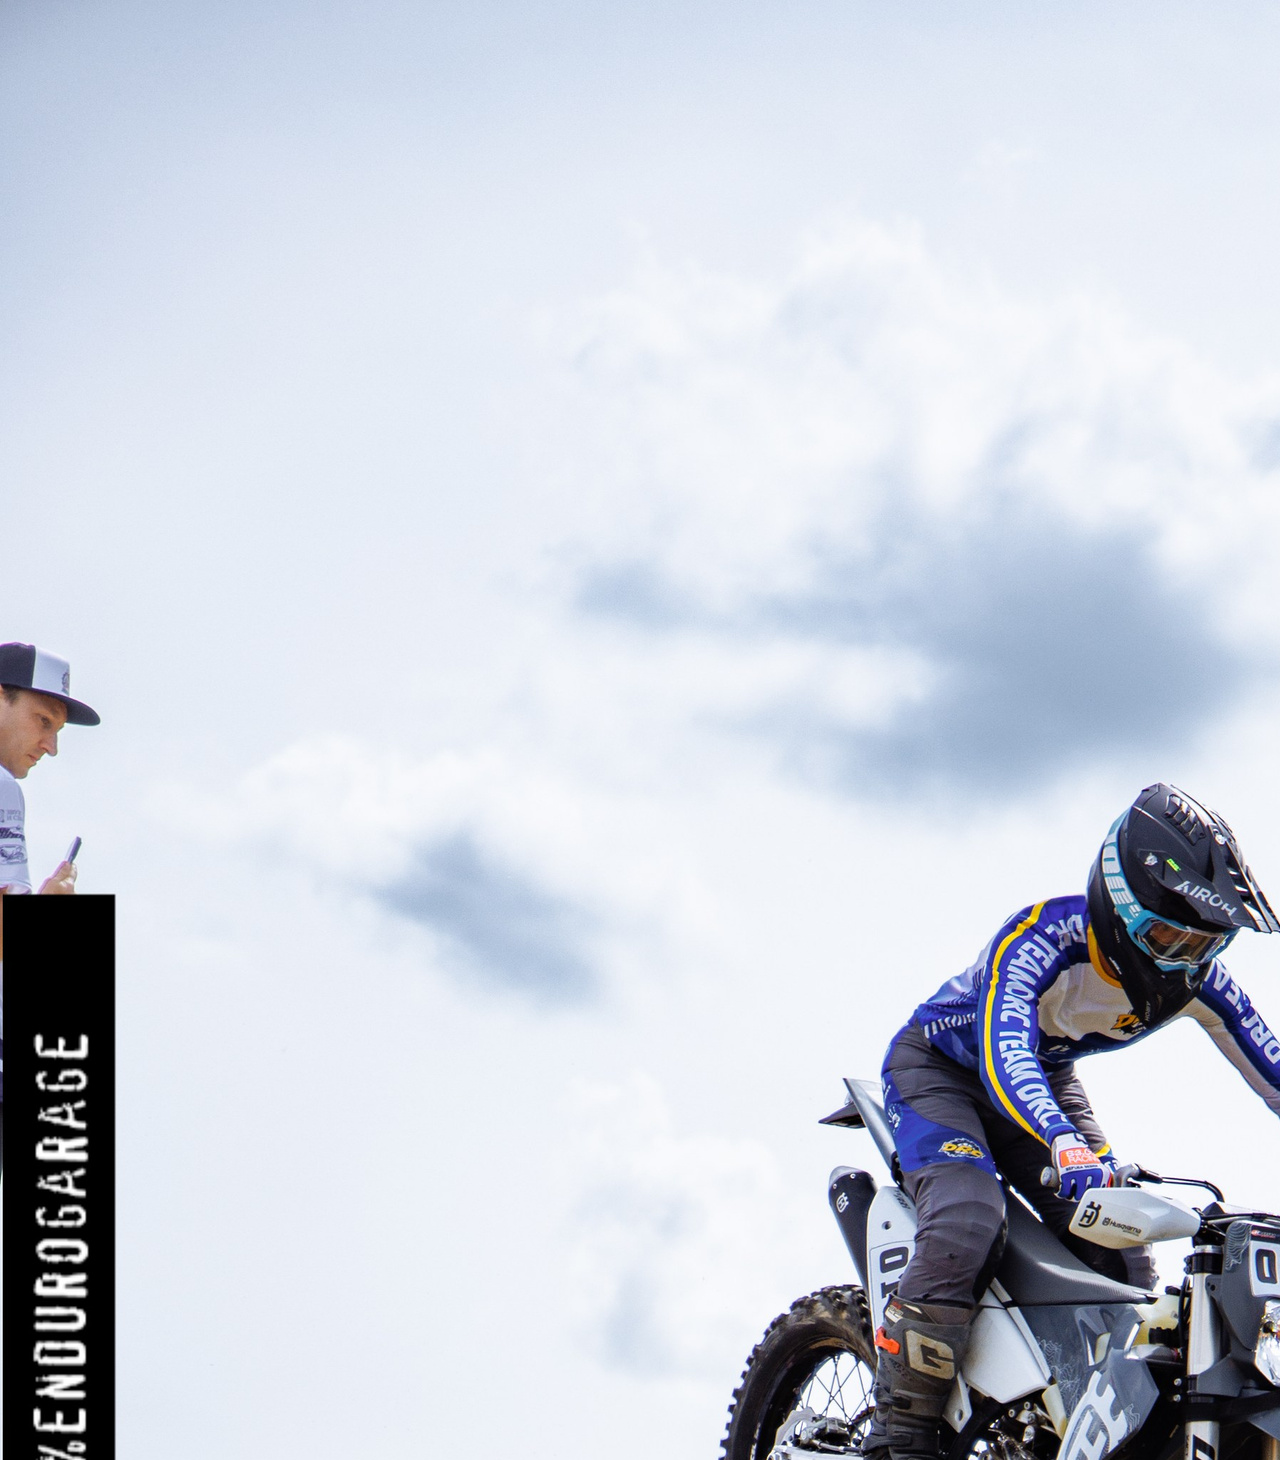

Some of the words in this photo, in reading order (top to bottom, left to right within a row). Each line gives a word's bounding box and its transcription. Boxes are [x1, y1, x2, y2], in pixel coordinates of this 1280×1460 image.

[1174, 880, 1238, 917] AIROH
[1006, 933, 1060, 986] TEAM
[998, 1030, 1044, 1087] TEAM
[942, 1143, 985, 1158] DRC
[1068, 1155, 1101, 1164] RACIN
[1109, 1219, 1142, 1235] Husqvarna
